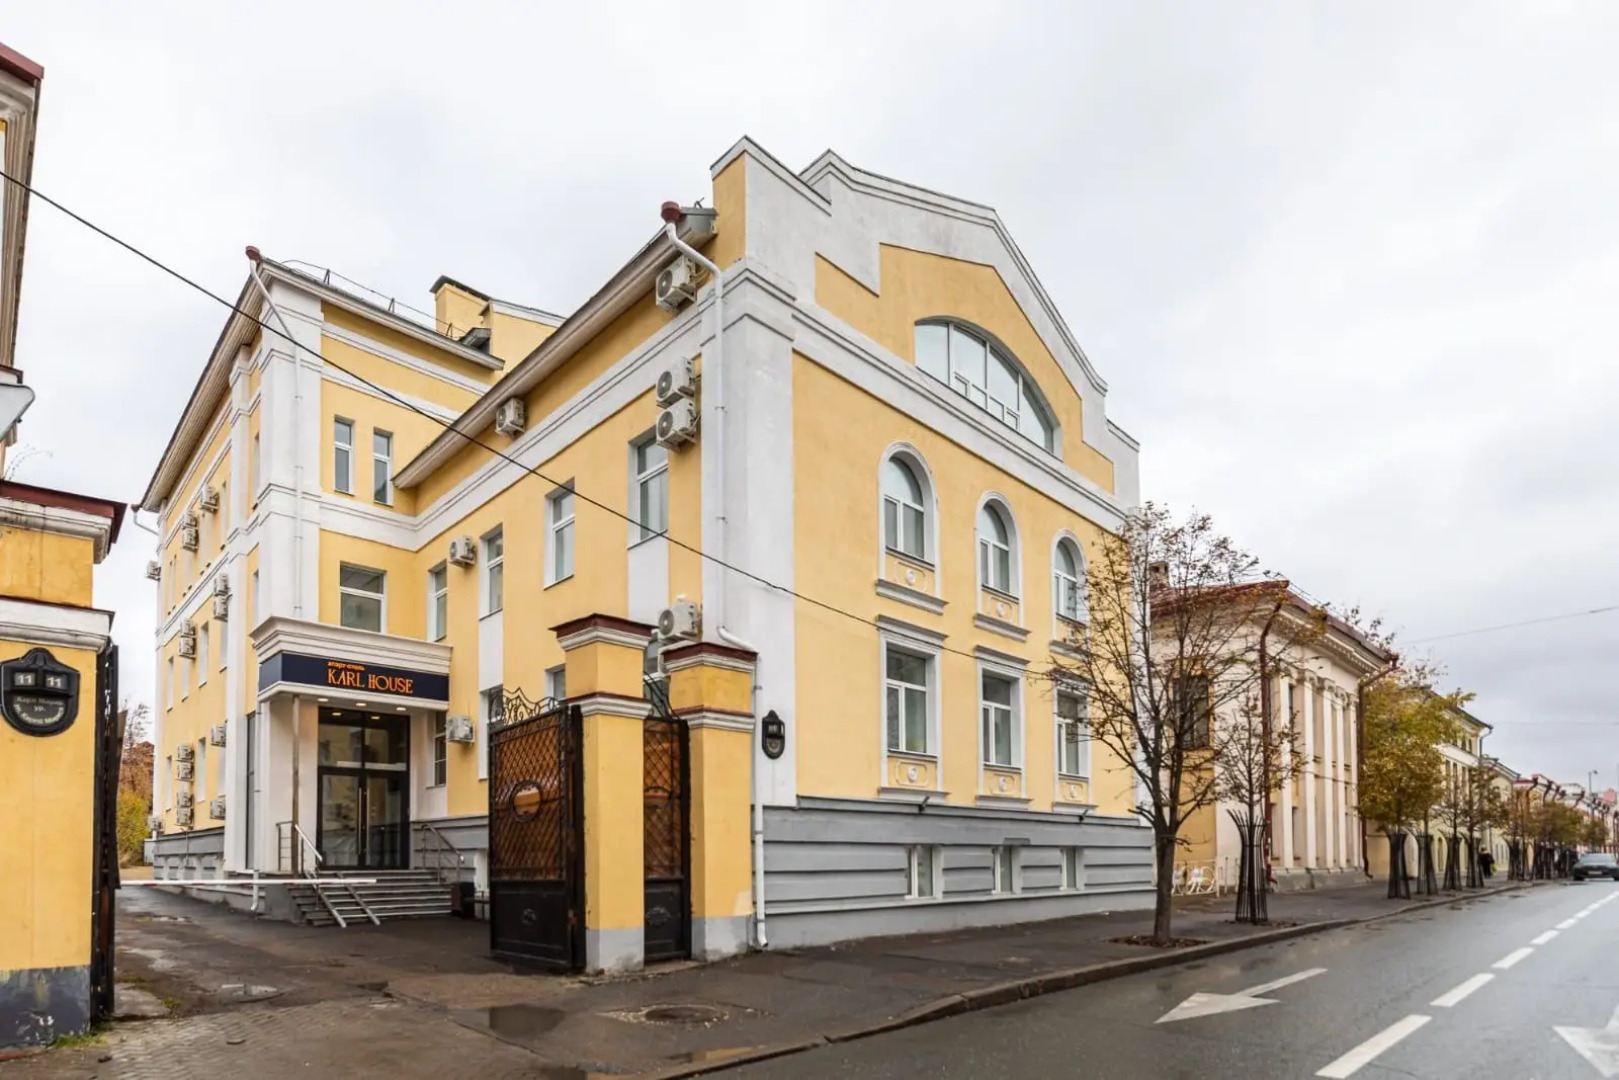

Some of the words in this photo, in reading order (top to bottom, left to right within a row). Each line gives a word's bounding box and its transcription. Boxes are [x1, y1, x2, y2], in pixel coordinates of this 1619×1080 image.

[18, 674, 33, 685] 11
[47, 676, 62, 688] 11
[327, 669, 365, 688] KARL
[368, 673, 413, 694] HOUSE
